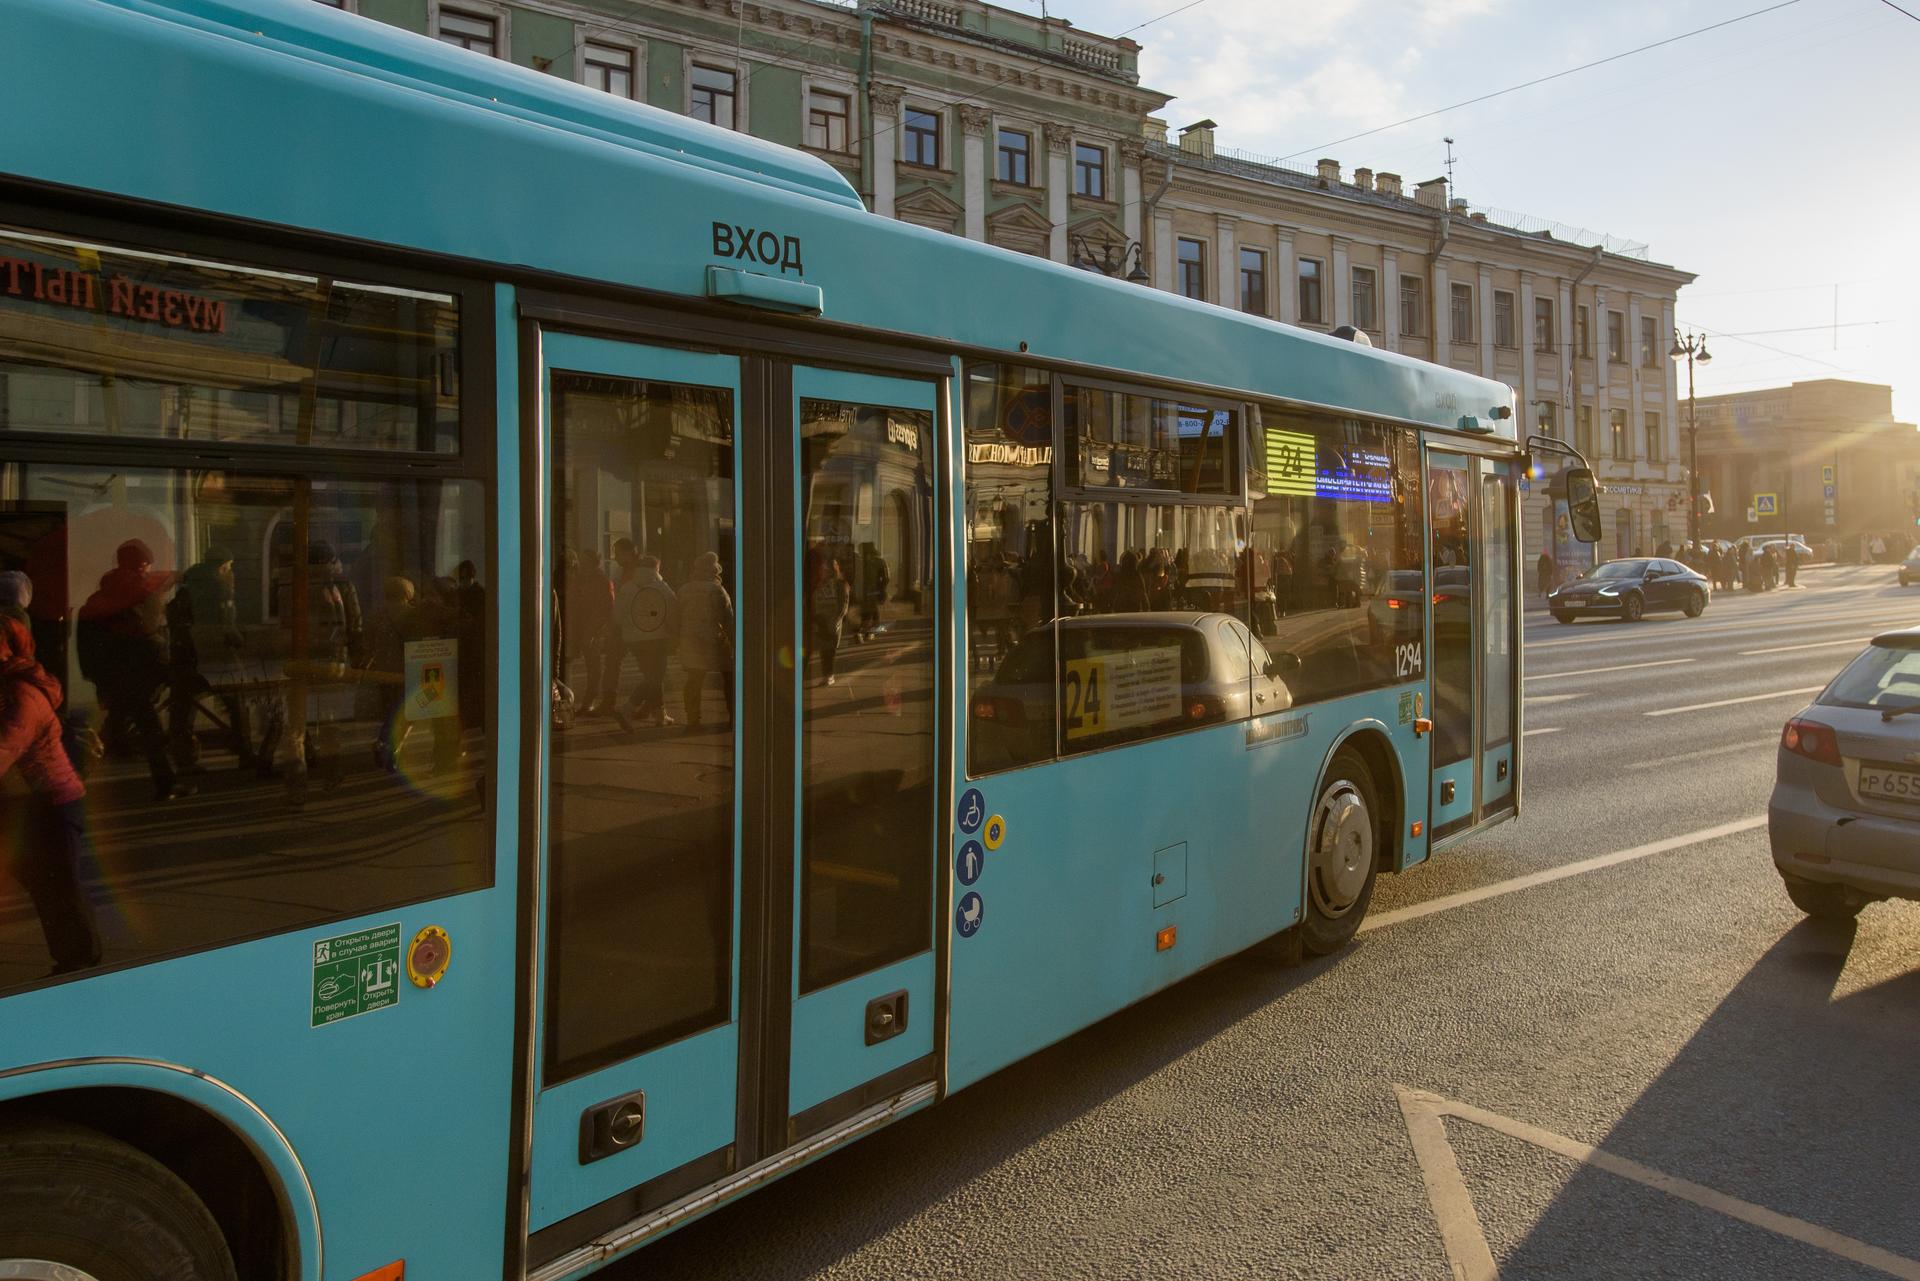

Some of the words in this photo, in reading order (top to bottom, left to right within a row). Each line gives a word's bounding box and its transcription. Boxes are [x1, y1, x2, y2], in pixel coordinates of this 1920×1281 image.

[712, 221, 803, 277] ВХОД
[1281, 444, 1303, 478] 24
[1395, 642, 1422, 677] 1294
[1067, 667, 1101, 729] 24
[331, 950, 337, 958] в
[338, 943, 368, 957] случае
[369, 937, 398, 949] аварии
[335, 932, 370, 948] Открыть
[371, 928, 396, 940] двери
[377, 953, 383, 961] 2
[363, 987, 394, 1002] Открыть
[366, 998, 390, 1011] двери
[314, 998, 356, 1014] Повернуть
[325, 1010, 345, 1022] кран
